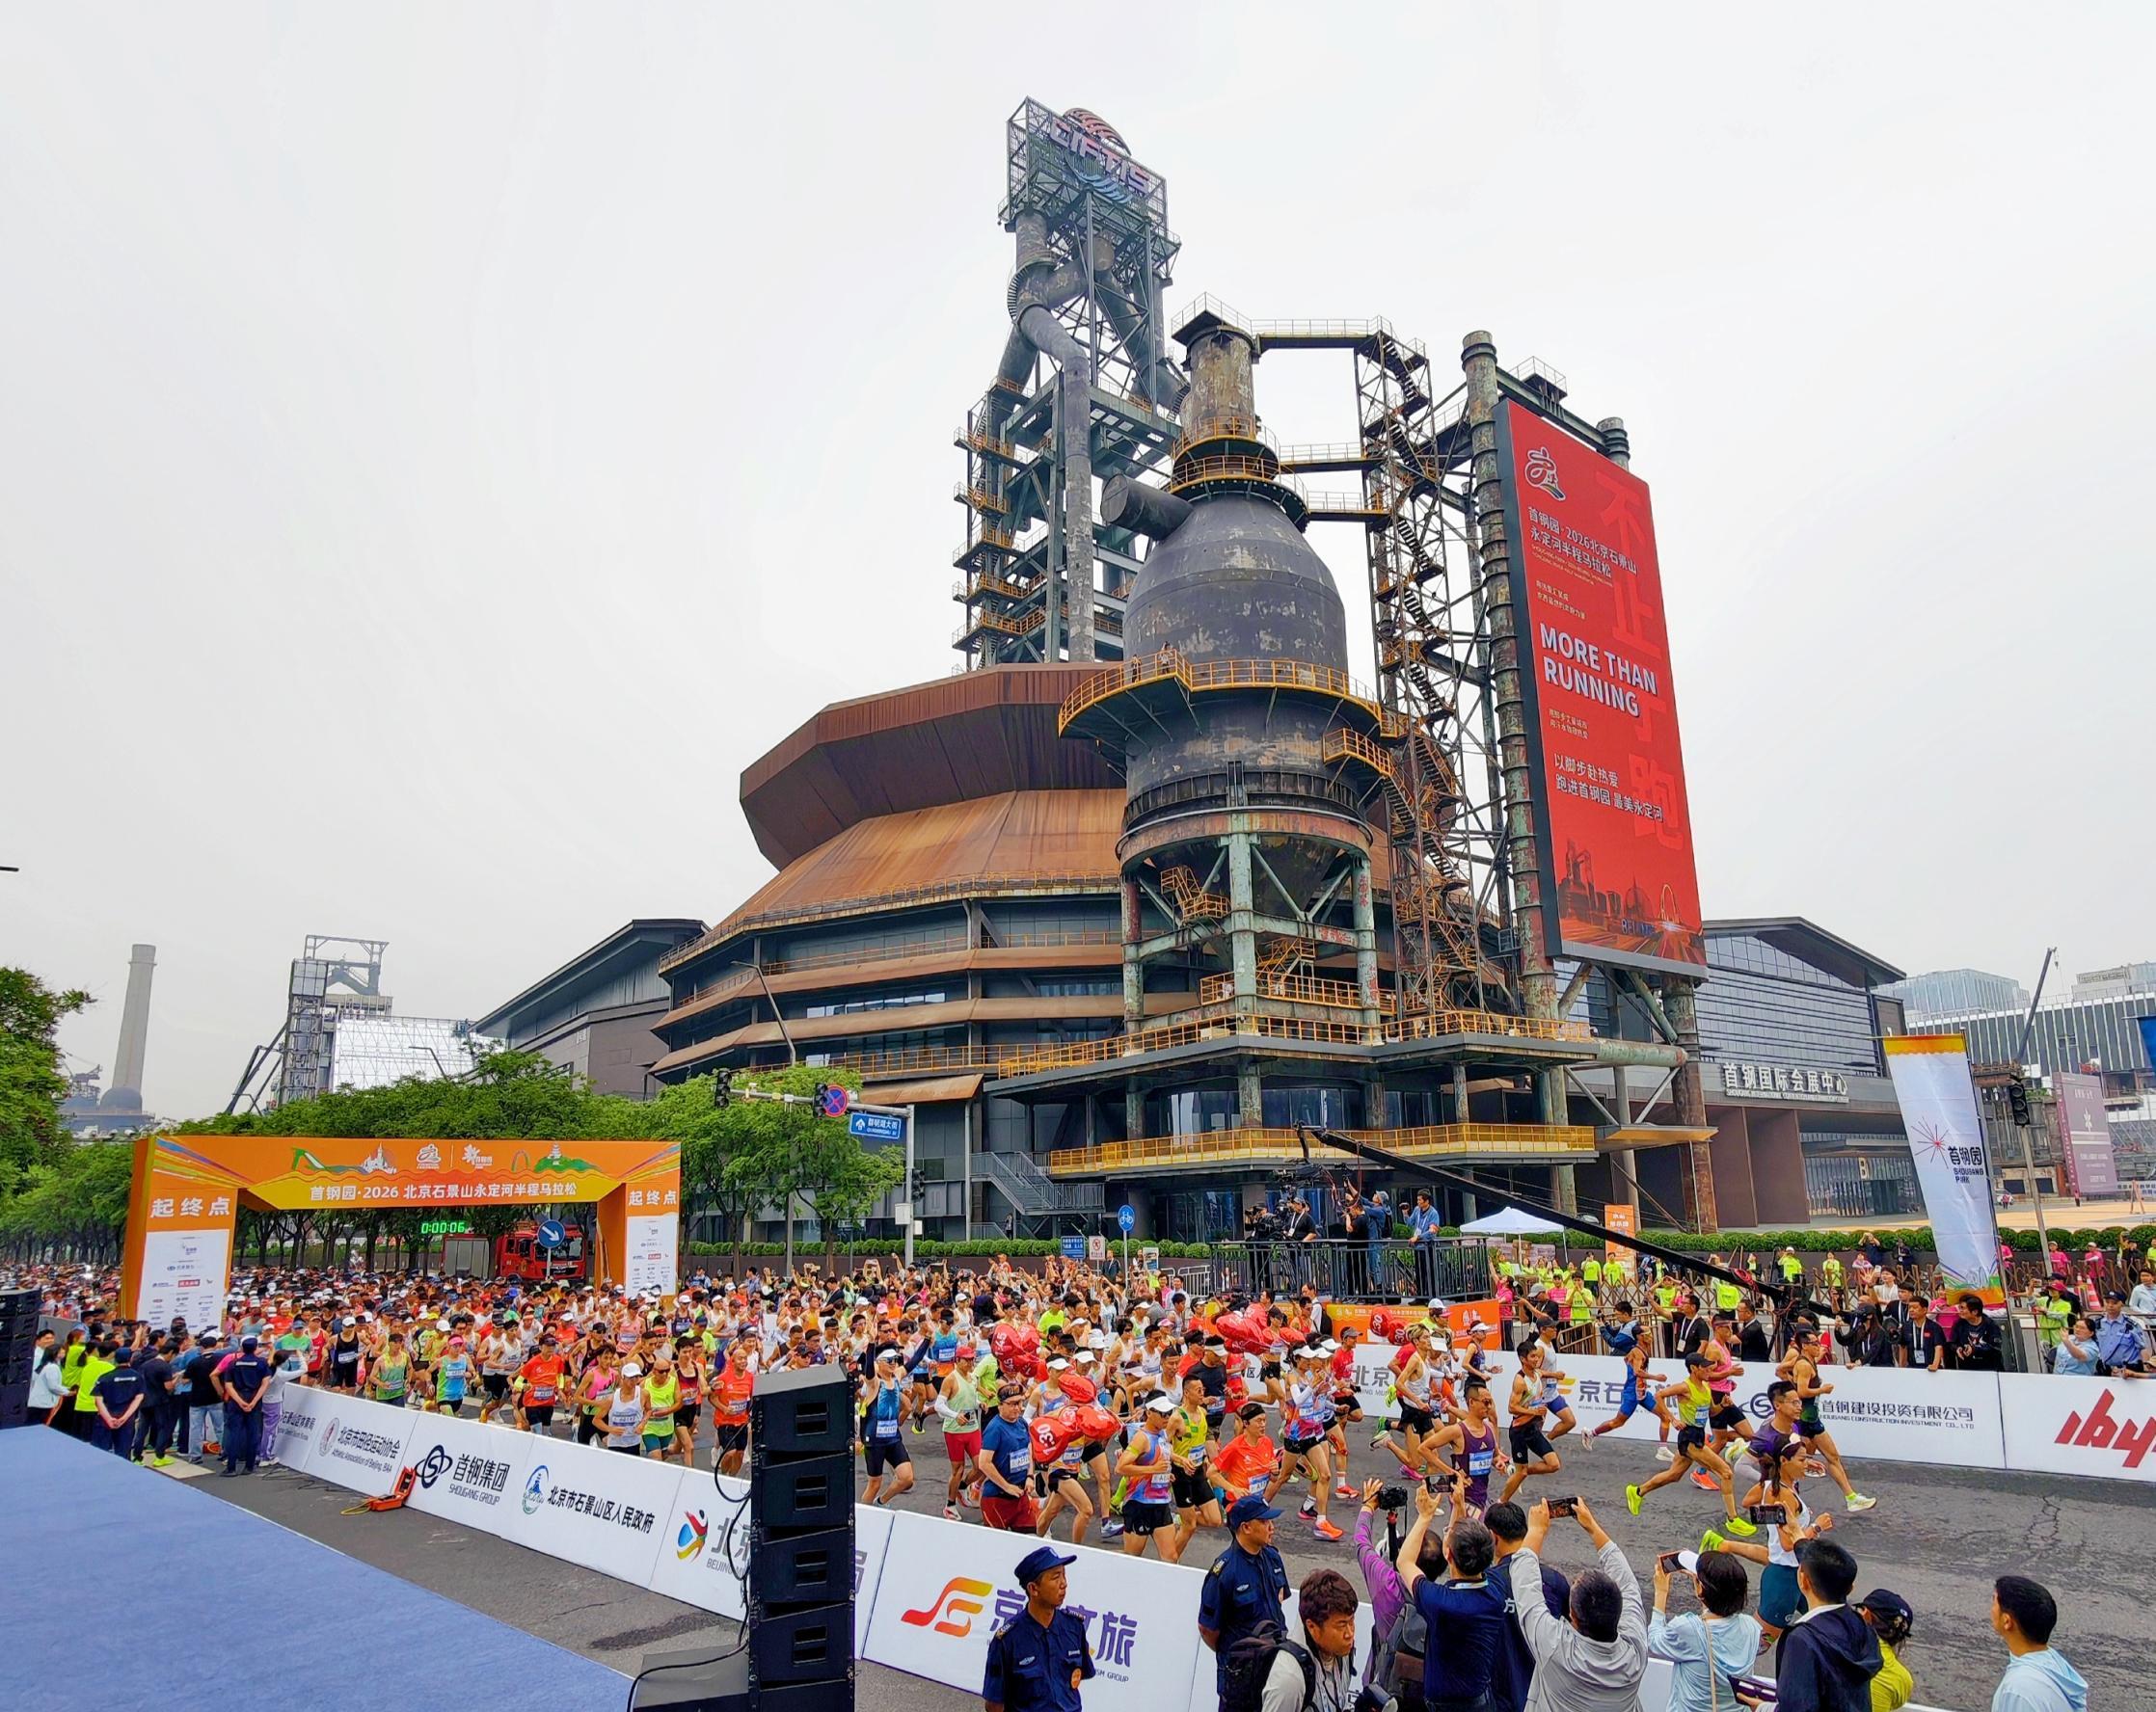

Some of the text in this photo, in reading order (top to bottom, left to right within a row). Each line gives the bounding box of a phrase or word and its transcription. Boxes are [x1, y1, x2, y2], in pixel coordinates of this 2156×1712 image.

[1049, 118, 1150, 195] CIFTIS
[1530, 525, 1612, 578] 永定河半程马拉松
[1540, 623, 1657, 695] MORE THAN
[1543, 655, 1639, 717] RUNNING
[1554, 753, 1619, 789] 以脚步赴热爱
[1555, 774, 1663, 822] 跑进首钢园 最美永定河
[1723, 1061, 1848, 1096] 首钢国际会展中心
[1948, 1145, 1982, 1165] 首钢园
[150, 1196, 230, 1218] 起终点
[310, 1182, 577, 1201] 首钢园·2026 北京石景山永定河半程马拉松
[628, 1190, 677, 1206] 起终点
[421, 1221, 465, 1234] 0:00:06
[1820, 1399, 1974, 1422] 首钢建设投资有限公司
[1900, 1419, 1942, 1428] INVESTMENT
[338, 1426, 400, 1458] 北京市田径运动协会
[1037, 1423, 1058, 1456] 1:30
[452, 1453, 510, 1492] 首钢集团
[448, 1484, 500, 1506] SHOUGANG GROUP
[547, 1485, 656, 1535] 北京市石景山区人民政府
[1107, 1672, 1129, 1684] GROUP
